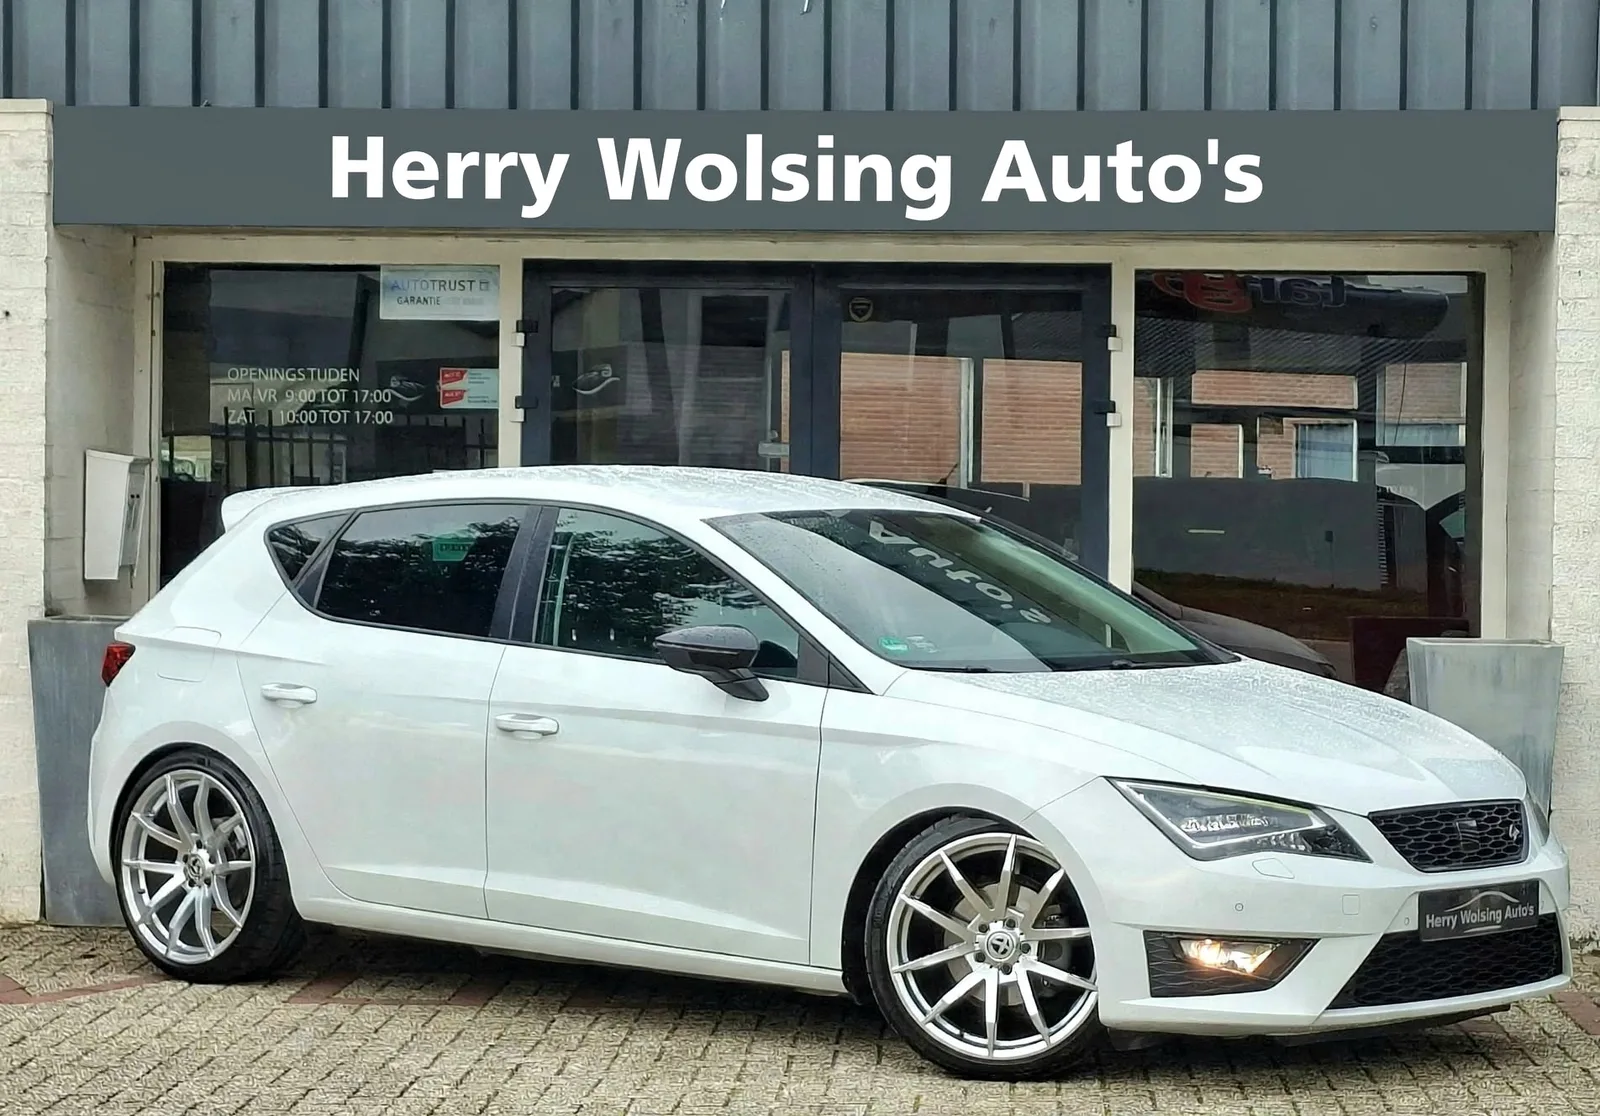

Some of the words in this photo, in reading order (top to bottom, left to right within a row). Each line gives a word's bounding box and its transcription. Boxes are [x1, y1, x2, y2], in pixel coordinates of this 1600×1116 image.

[333, 136, 569, 218] Herry
[598, 134, 951, 220] Wolsing
[982, 139, 1262, 202] Auto's
[390, 279, 476, 292] AUTOTRUST
[396, 296, 440, 306] GARANTIE
[285, 388, 316, 404] 9:00
[319, 389, 349, 404] TOT
[353, 389, 392, 404] 17:00
[280, 410, 317, 425] 10:00
[319, 410, 351, 425] TOT
[355, 410, 393, 425] 17:00
[1426, 913, 1458, 930] Herry
[1460, 907, 1503, 925] Wolsing
[1505, 902, 1535, 920] Auto's
